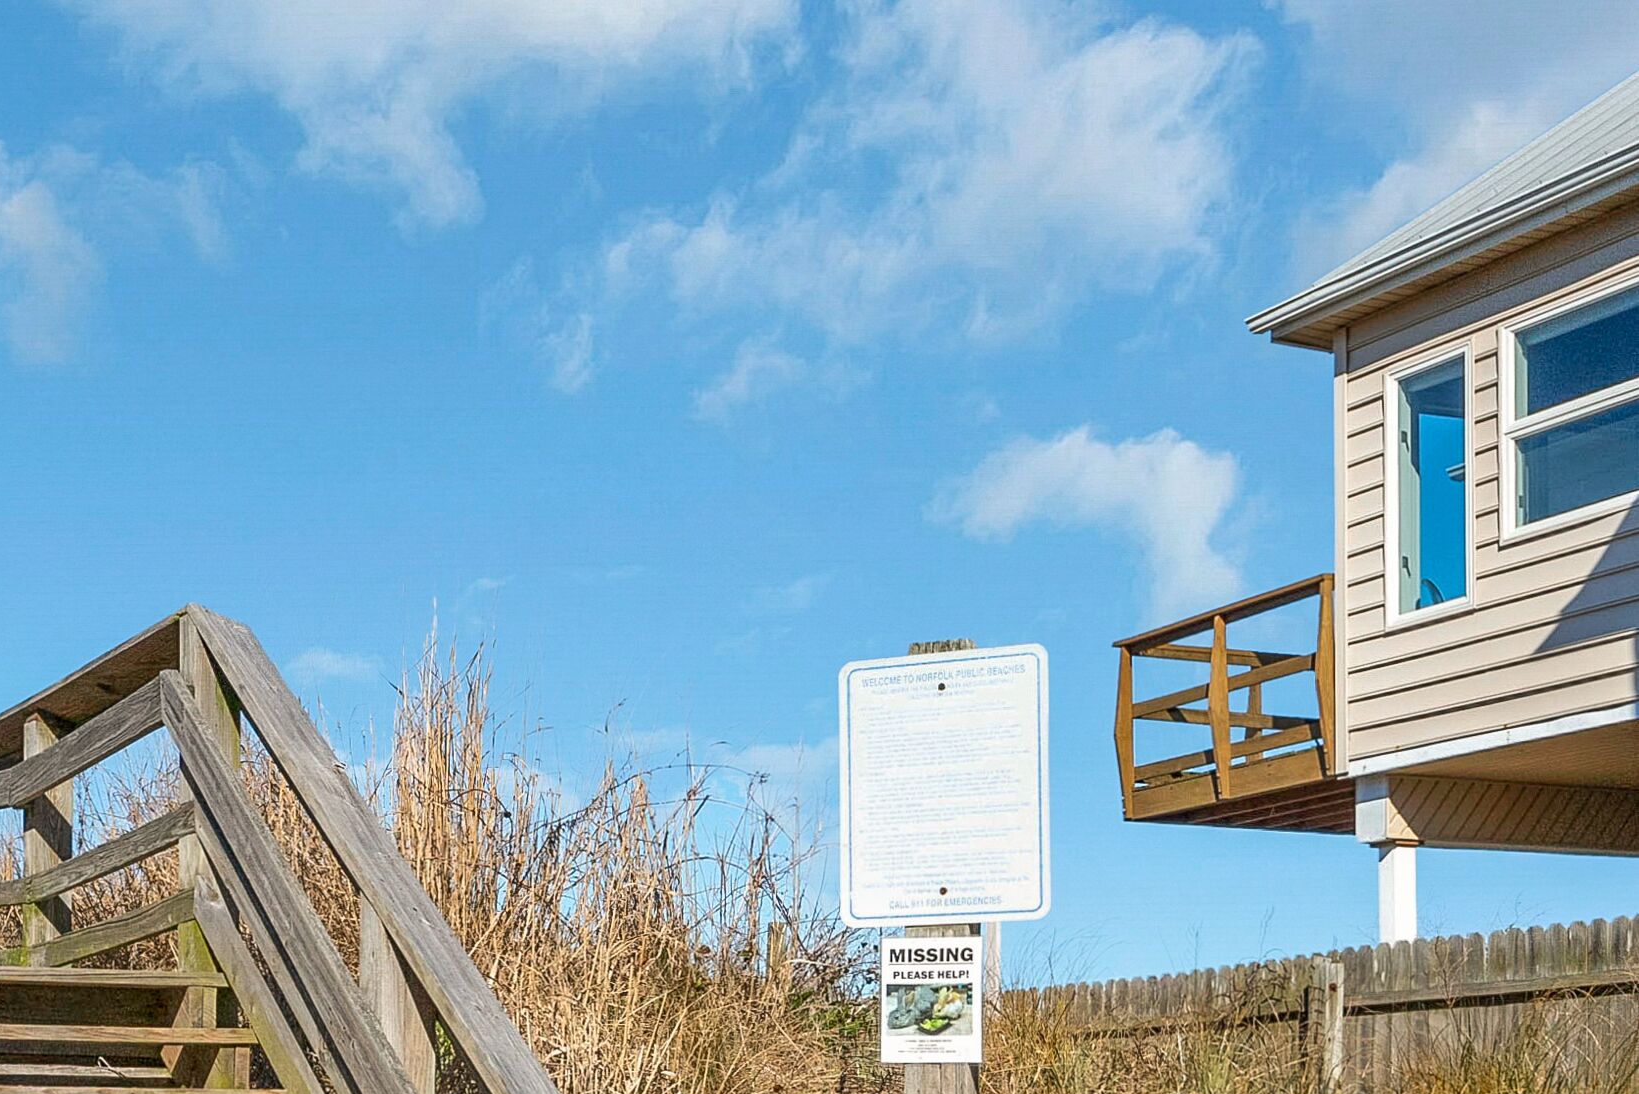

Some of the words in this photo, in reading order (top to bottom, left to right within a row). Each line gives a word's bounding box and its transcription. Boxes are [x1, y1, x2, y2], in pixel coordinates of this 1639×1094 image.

[862, 675, 901, 688] WELCOME
[904, 674, 914, 683] TO
[915, 670, 954, 683] NORFOLK
[955, 668, 984, 679] PUBLIC
[986, 664, 1026, 677] BEACHES
[889, 900, 910, 910] CALL
[926, 898, 942, 908] FOR
[944, 896, 1002, 906] EMERGENCIES
[889, 947, 974, 963] MISSING
[893, 971, 935, 980] PLEASE
[937, 970, 970, 979] HELP!
